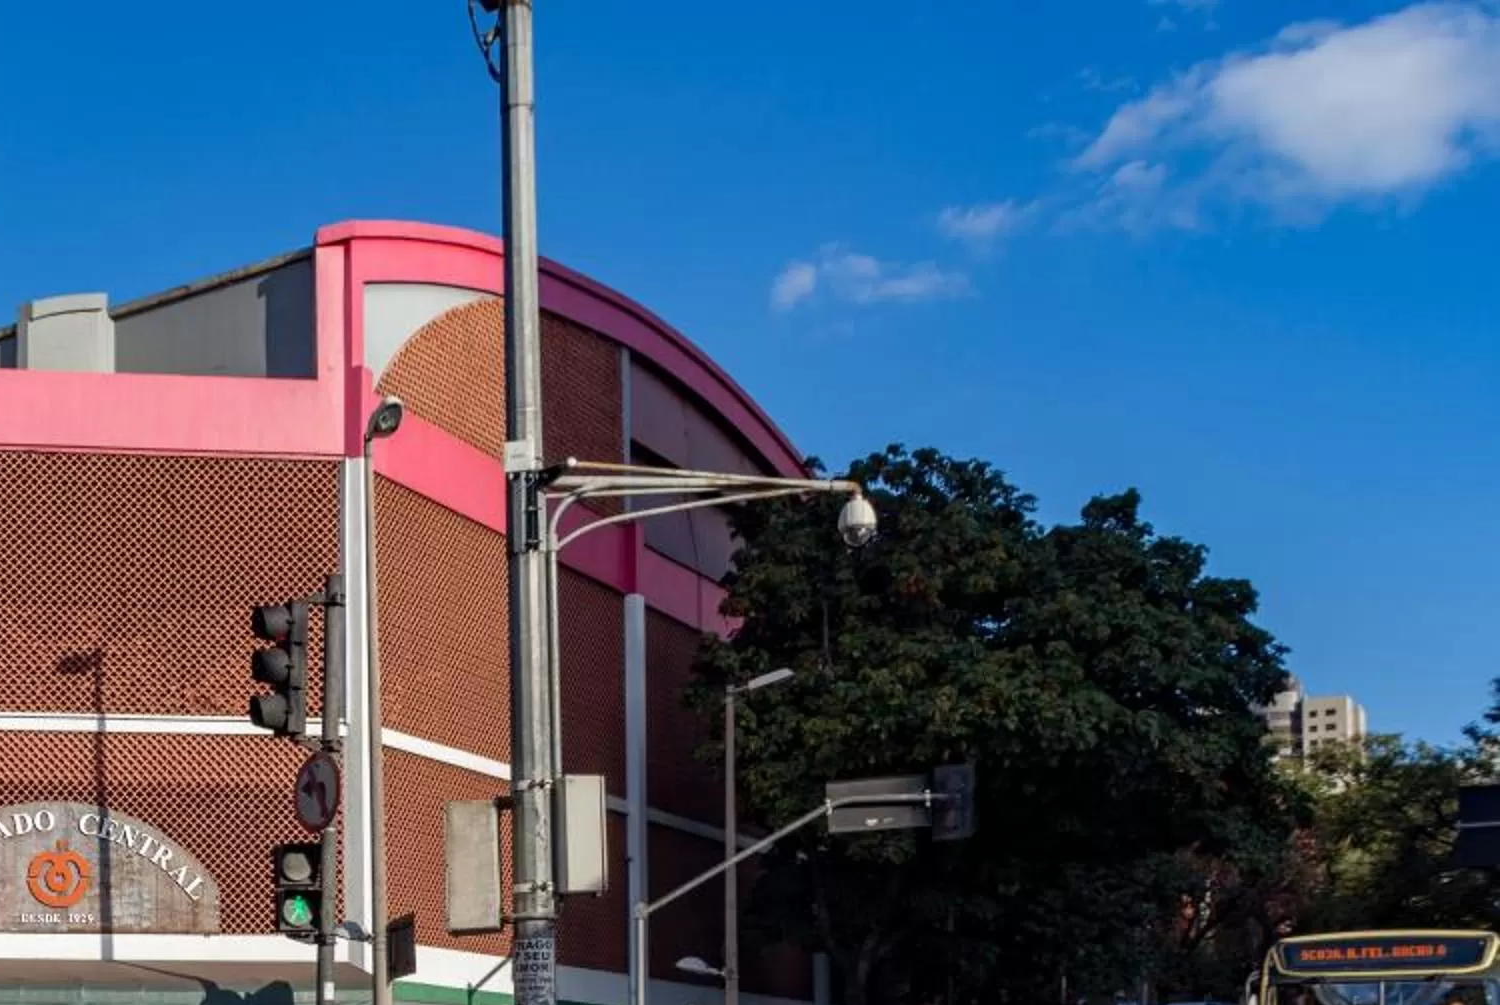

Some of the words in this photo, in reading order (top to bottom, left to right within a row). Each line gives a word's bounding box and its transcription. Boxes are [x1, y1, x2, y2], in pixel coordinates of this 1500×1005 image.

[78, 812, 206, 902] CENTRAL
[20, 912, 61, 923] DESDE
[68, 912, 95, 923] 1929
